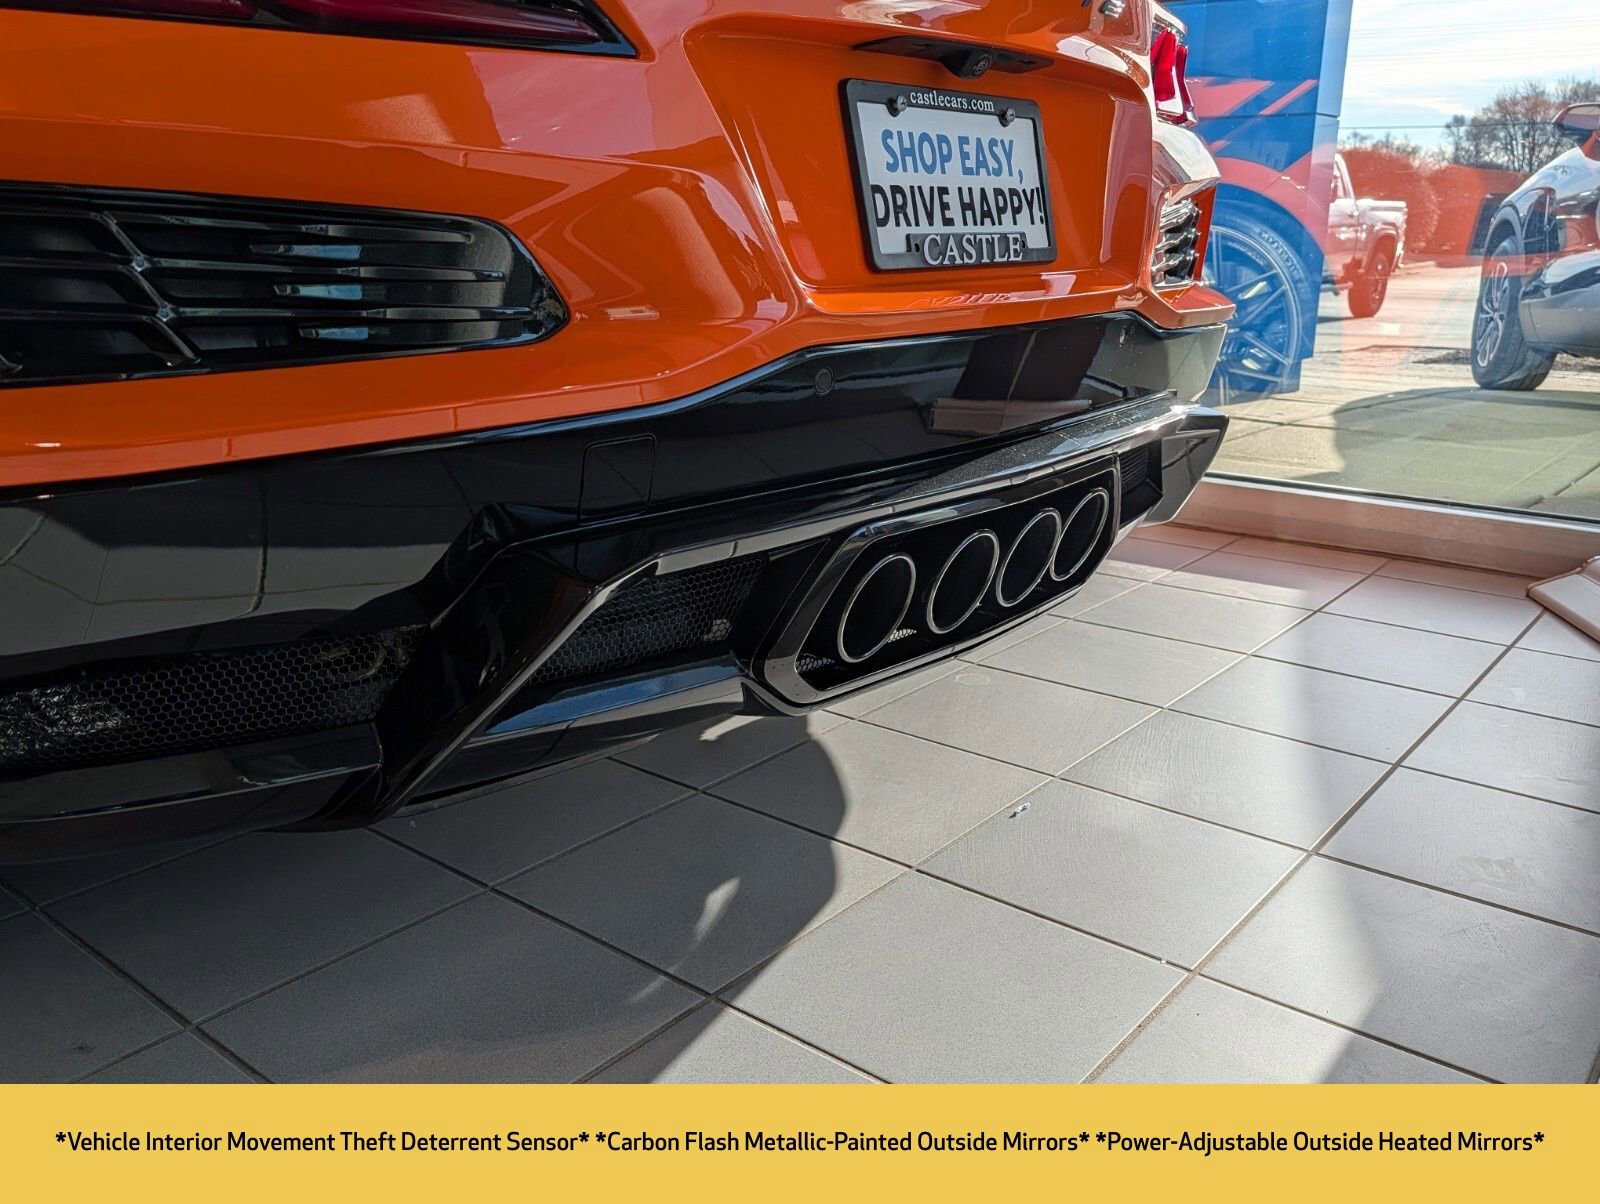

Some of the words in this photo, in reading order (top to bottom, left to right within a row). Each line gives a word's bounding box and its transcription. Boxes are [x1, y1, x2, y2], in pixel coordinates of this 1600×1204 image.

[909, 90, 995, 112] castlecars.com
[881, 128, 952, 175] SHOP
[957, 135, 1023, 185] EASY,
[870, 184, 956, 228] DRIVE
[957, 186, 1045, 227] HAPPY!
[923, 233, 1023, 265] CASTLE
